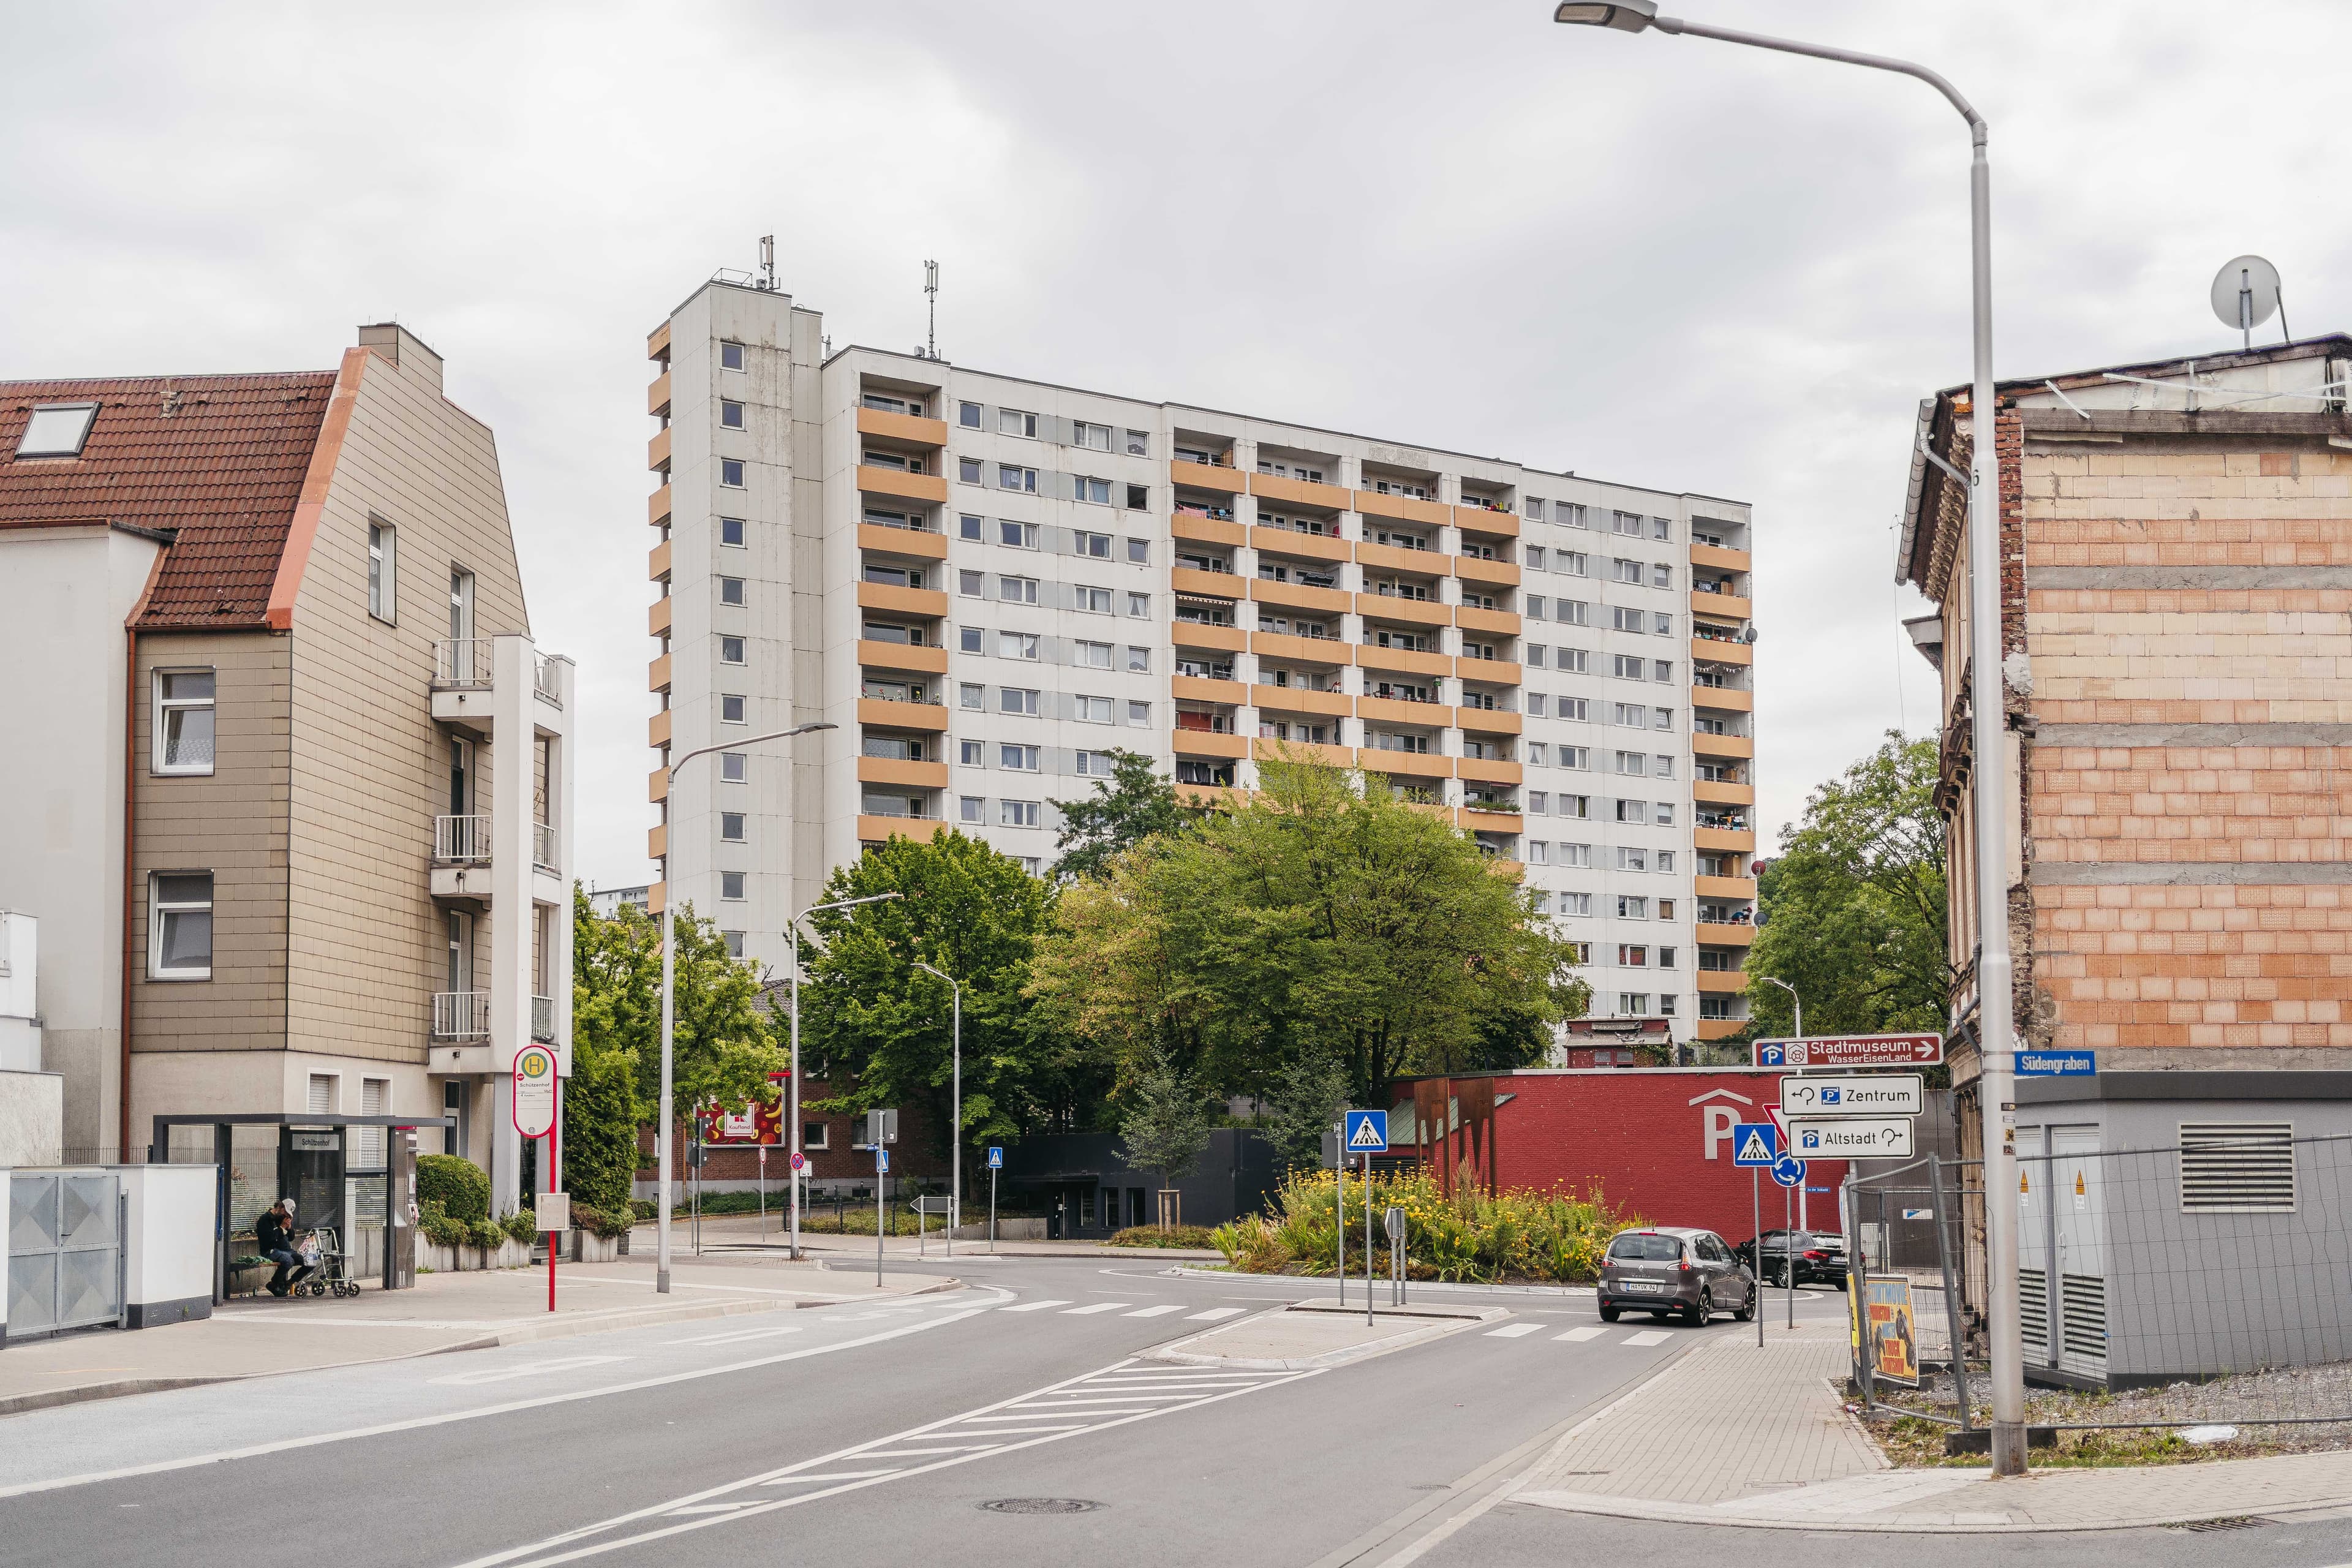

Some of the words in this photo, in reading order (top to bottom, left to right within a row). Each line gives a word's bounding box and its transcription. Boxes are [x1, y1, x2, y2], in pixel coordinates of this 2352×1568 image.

[1973, 469, 1979, 486] 6
[1768, 1050, 1777, 1064] P
[1811, 1041, 1911, 1054] Stadtmuseum
[1828, 1054, 1912, 1064] WasserEisenLand
[529, 1058, 540, 1072] H
[2022, 1055, 2090, 1074] Südengraben
[1826, 1091, 1834, 1100] P
[1847, 1090, 1910, 1102] Zentrum
[1704, 1106, 1742, 1159] P
[1807, 1135, 1815, 1147] P
[1825, 1133, 1876, 1145] Altstadt
[1885, 1340, 1901, 1357] TRUCK
